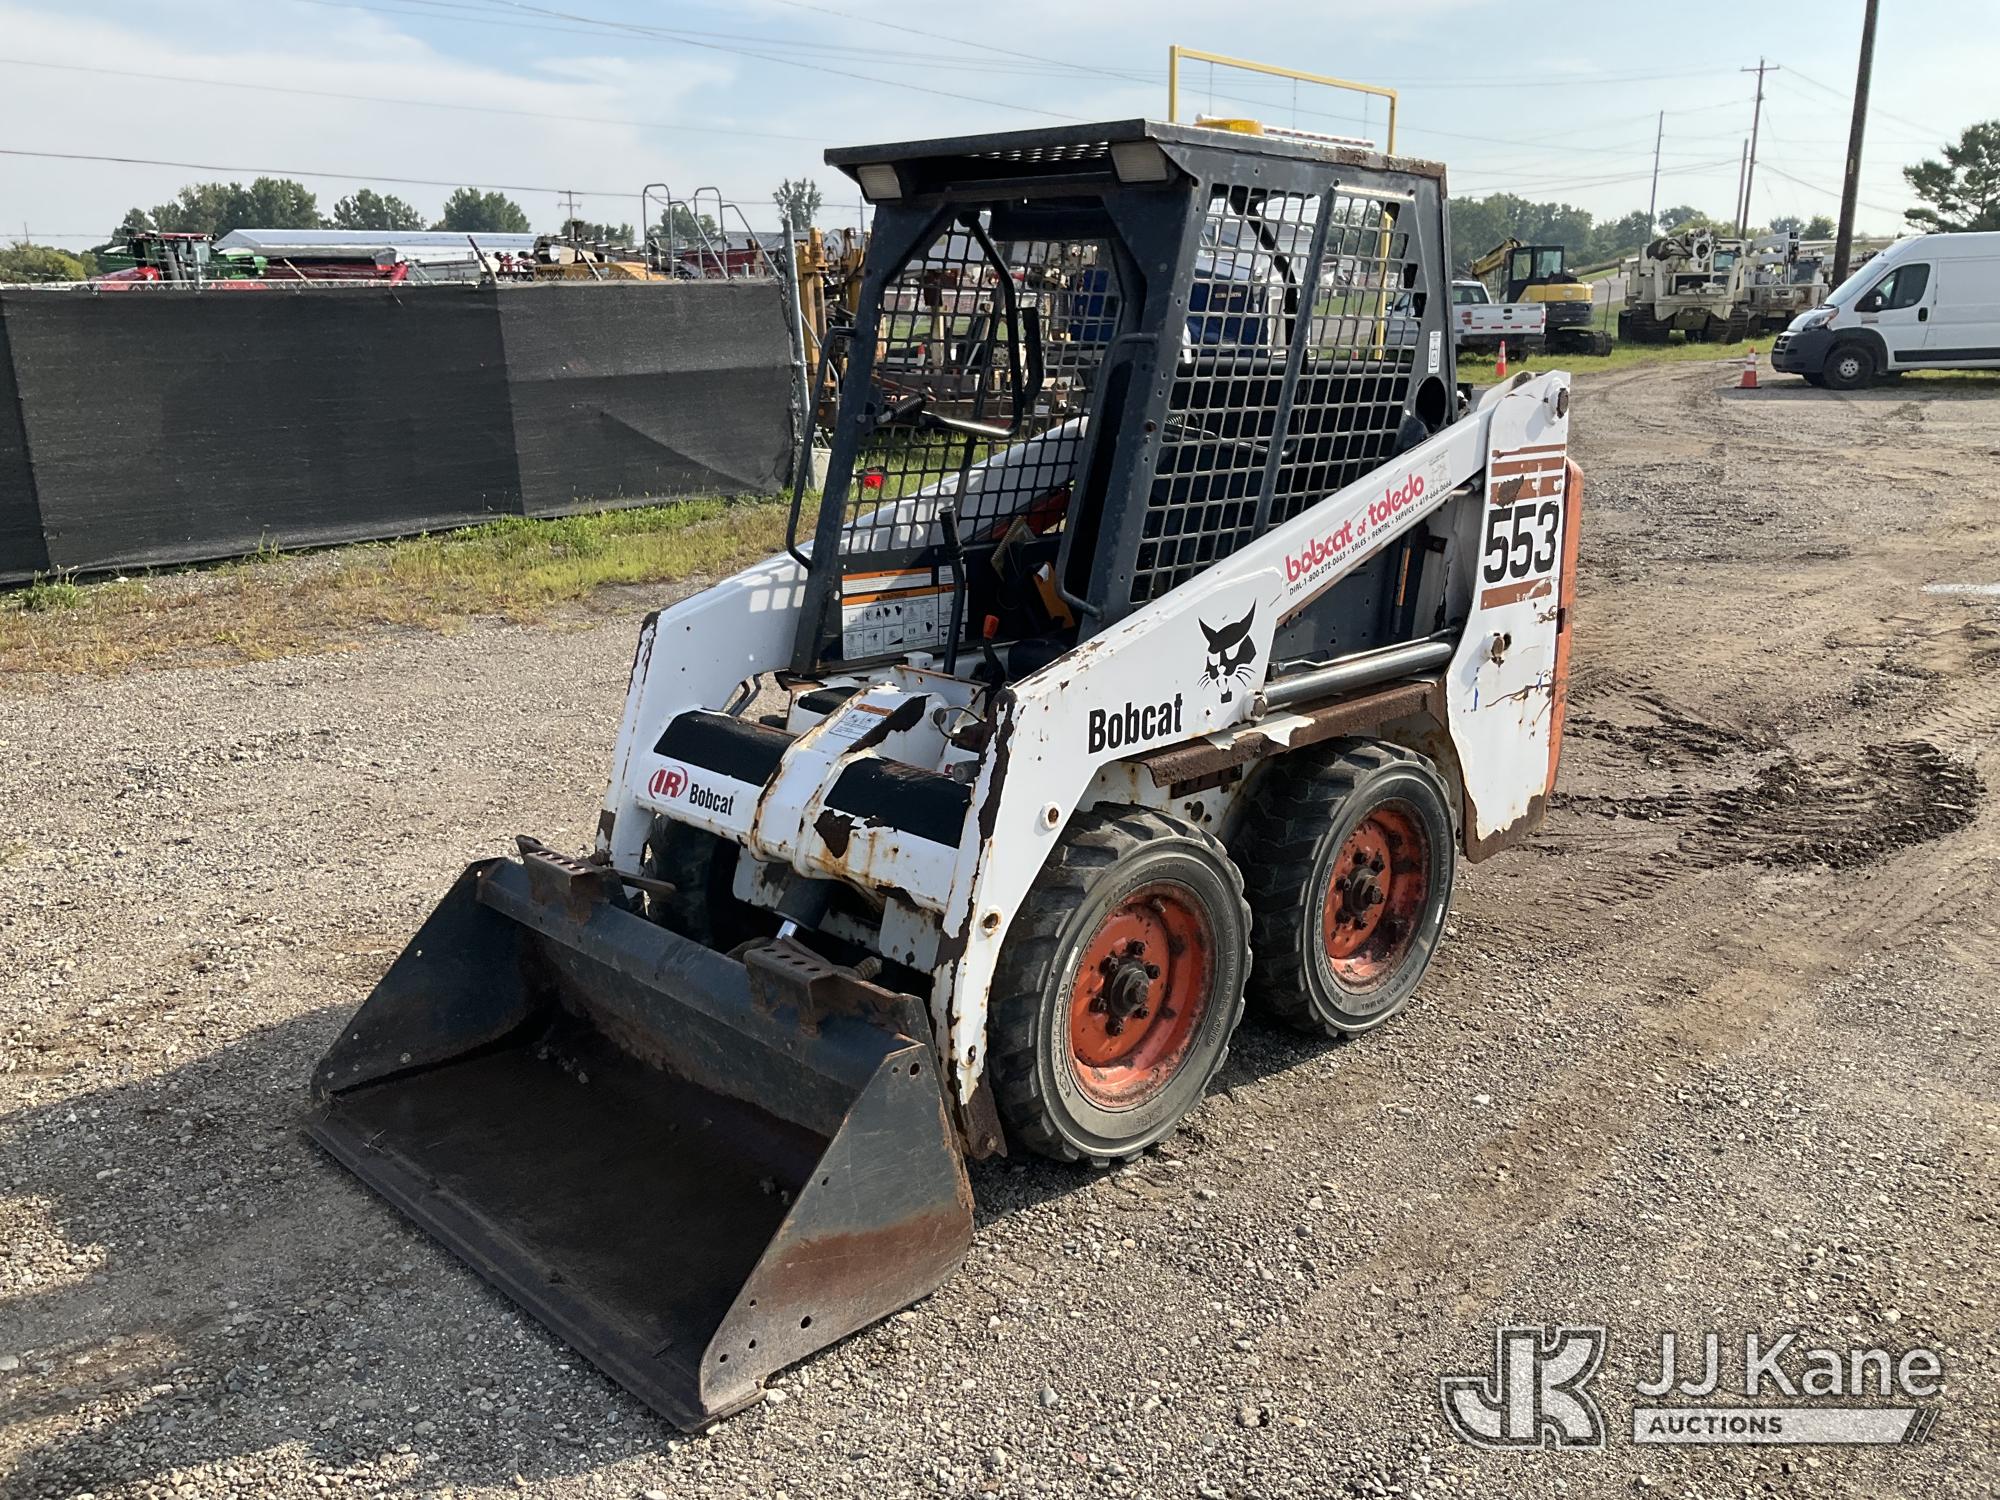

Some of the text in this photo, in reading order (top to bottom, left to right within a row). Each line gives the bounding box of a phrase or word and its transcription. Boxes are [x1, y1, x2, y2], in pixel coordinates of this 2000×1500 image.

[1285, 473, 1424, 582] bobcat of toledo
[1351, 537, 1367, 553] SALES
[1371, 522, 1391, 539] RENTAL
[1395, 504, 1415, 523] SERVICE
[1483, 501, 1560, 584] 553
[1088, 693, 1183, 754] Bobcat
[688, 782, 734, 816] Bobcat
